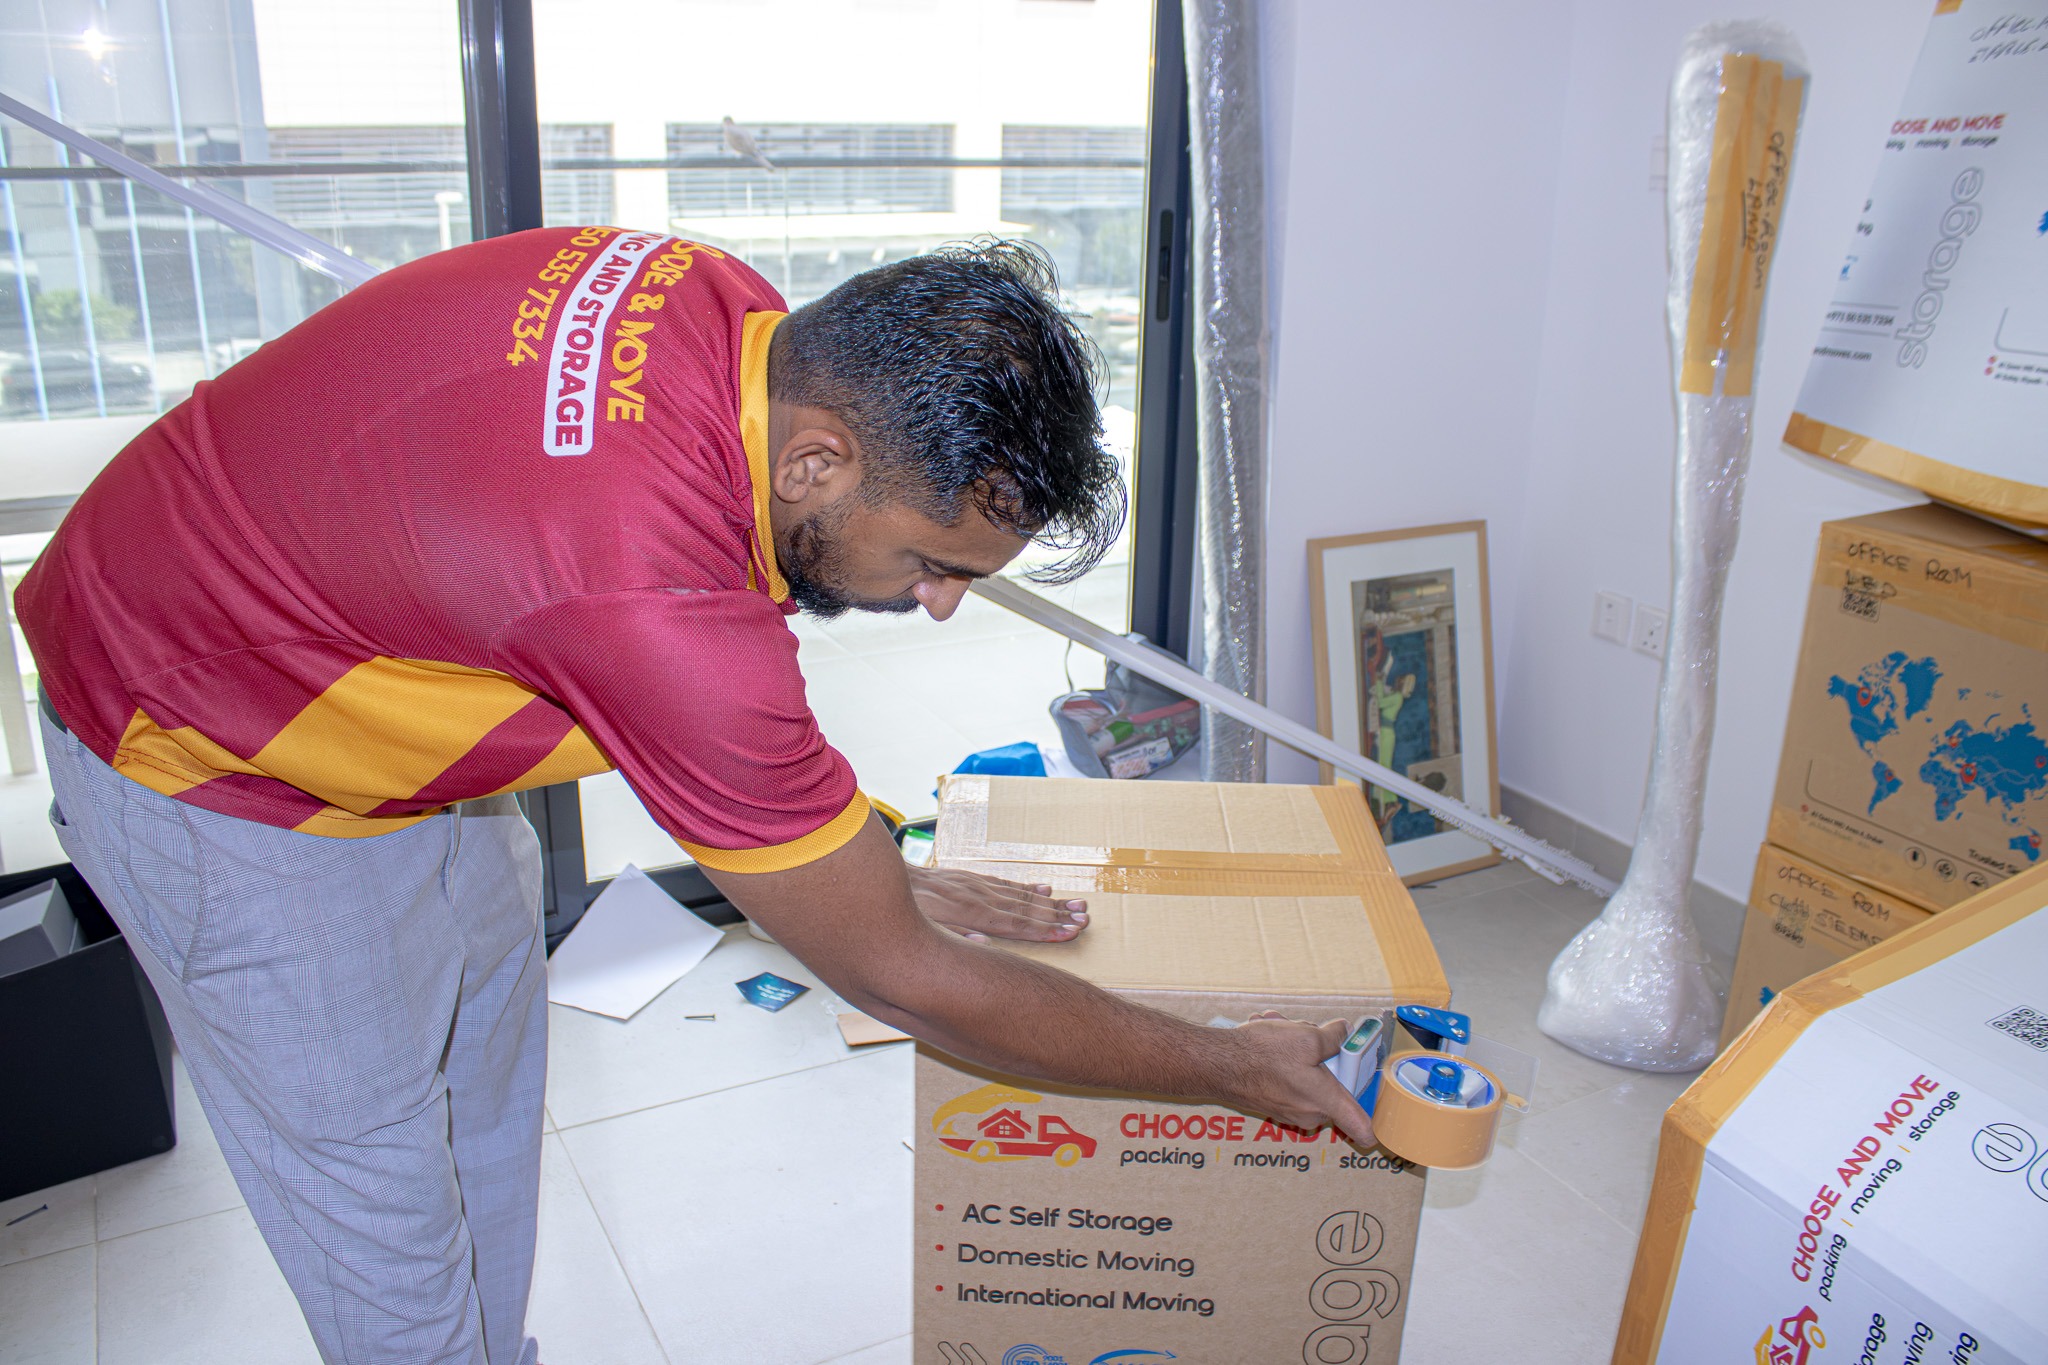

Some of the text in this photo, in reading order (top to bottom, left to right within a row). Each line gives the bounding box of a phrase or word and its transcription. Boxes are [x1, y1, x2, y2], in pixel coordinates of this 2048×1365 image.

[1930, 118, 1961, 132] AND
[1961, 113, 2007, 131] MOVE
[589, 254, 633, 296] AND
[1895, 166, 1985, 370] storage
[506, 226, 620, 367] 50 535 7334
[627, 293, 664, 313] &
[555, 297, 604, 447] STORAGE
[607, 319, 655, 423] MOVE
[1119, 1113, 1245, 1141] CHOOSE
[1253, 1117, 1320, 1143] AND
[1120, 1147, 1205, 1169] packing
[1234, 1150, 1310, 1172] moving
[1791, 1074, 1940, 1283] CHOOSE AND MOVE
[1819, 1090, 1960, 1302] packing moving storage
[962, 1203, 1173, 1236] AC Self Storage
[957, 1243, 1195, 1277] Domestic Moving
[957, 1283, 1215, 1317] International Moving
[1853, 1313, 1887, 1365] orage
